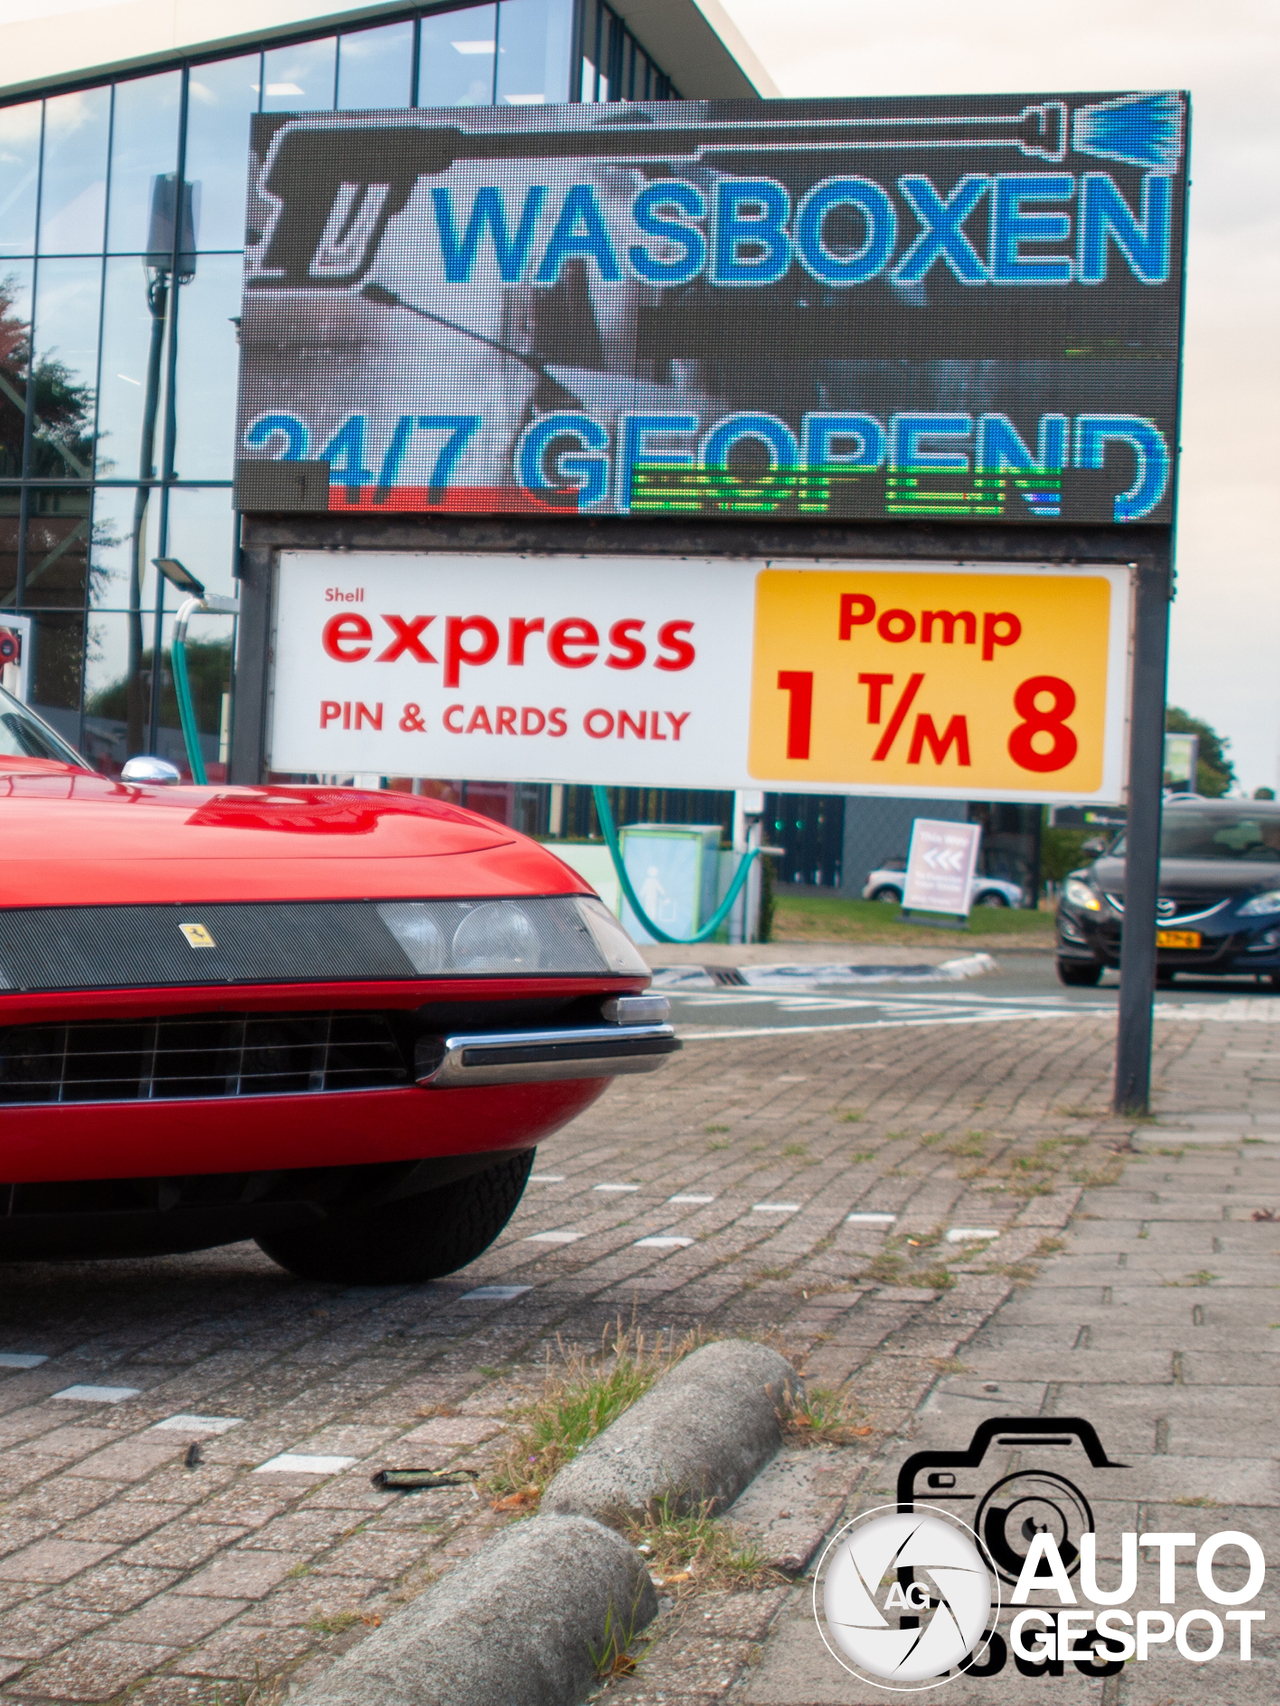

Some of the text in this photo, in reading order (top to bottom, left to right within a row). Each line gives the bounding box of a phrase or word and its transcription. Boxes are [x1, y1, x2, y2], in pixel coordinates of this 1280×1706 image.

[430, 173, 1171, 287] WASBOXEN
[244, 410, 483, 506] 24/7
[325, 587, 365, 602] Shell
[838, 592, 1023, 662] Pomp
[321, 611, 697, 689] express
[320, 700, 692, 742] PIN & CARDS ONLY
[777, 670, 814, 760] 1
[1006, 674, 1079, 774] 8
